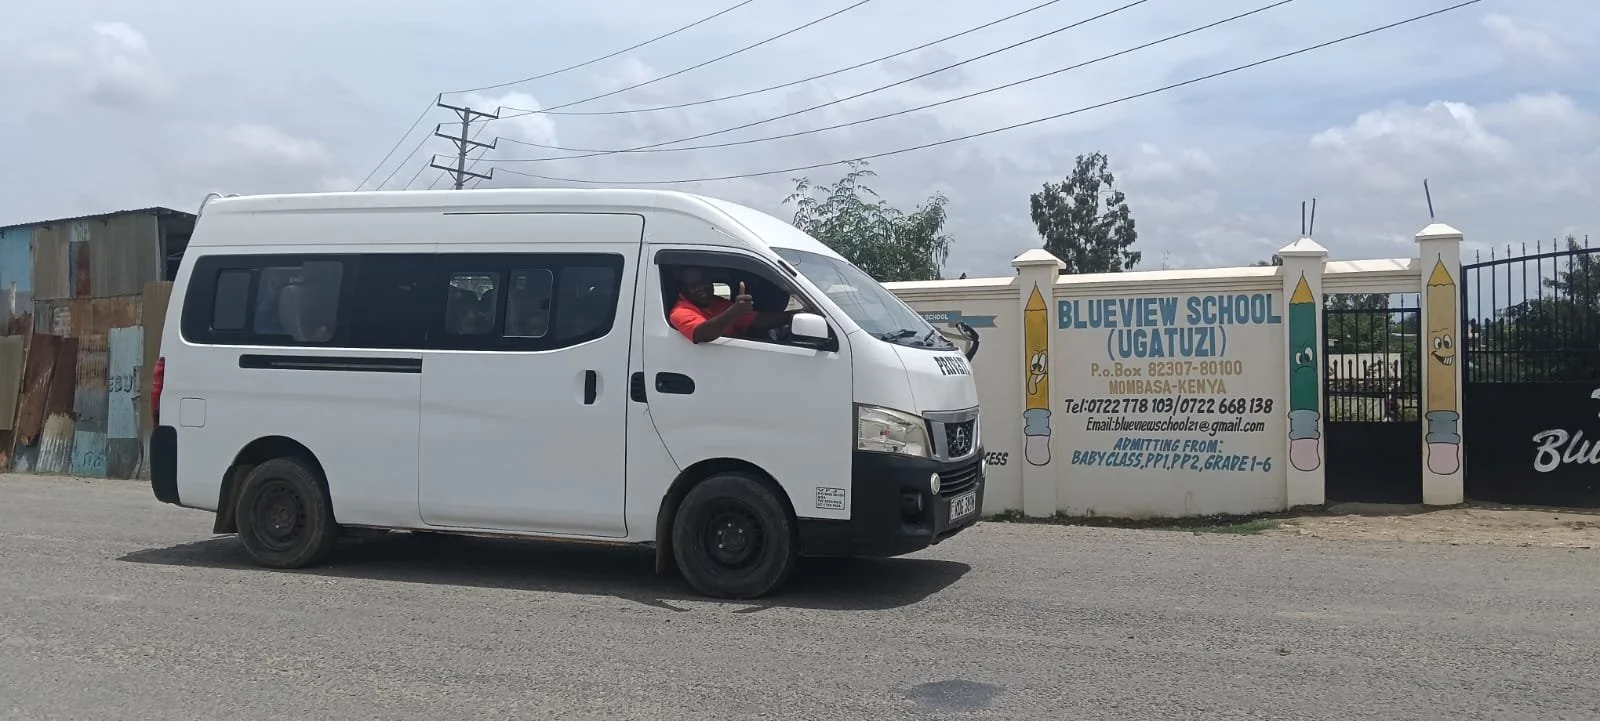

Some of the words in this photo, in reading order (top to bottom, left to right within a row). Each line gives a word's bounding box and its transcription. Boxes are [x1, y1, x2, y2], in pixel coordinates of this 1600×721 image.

[1058, 297, 1178, 329] BLUEVIEW
[1187, 294, 1281, 325] SCHOOL
[1107, 326, 1226, 360] (UGATUZI)
[1148, 360, 1242, 376] 82307-80100
[1109, 379, 1227, 394] MOMBASA-KENYA
[1152, 394, 1215, 416] 103/0722
[1219, 398, 1246, 414] 668
[1249, 398, 1273, 414] 138
[1113, 437, 1180, 452] ADMITTING
[1182, 439, 1224, 453] FROM:
